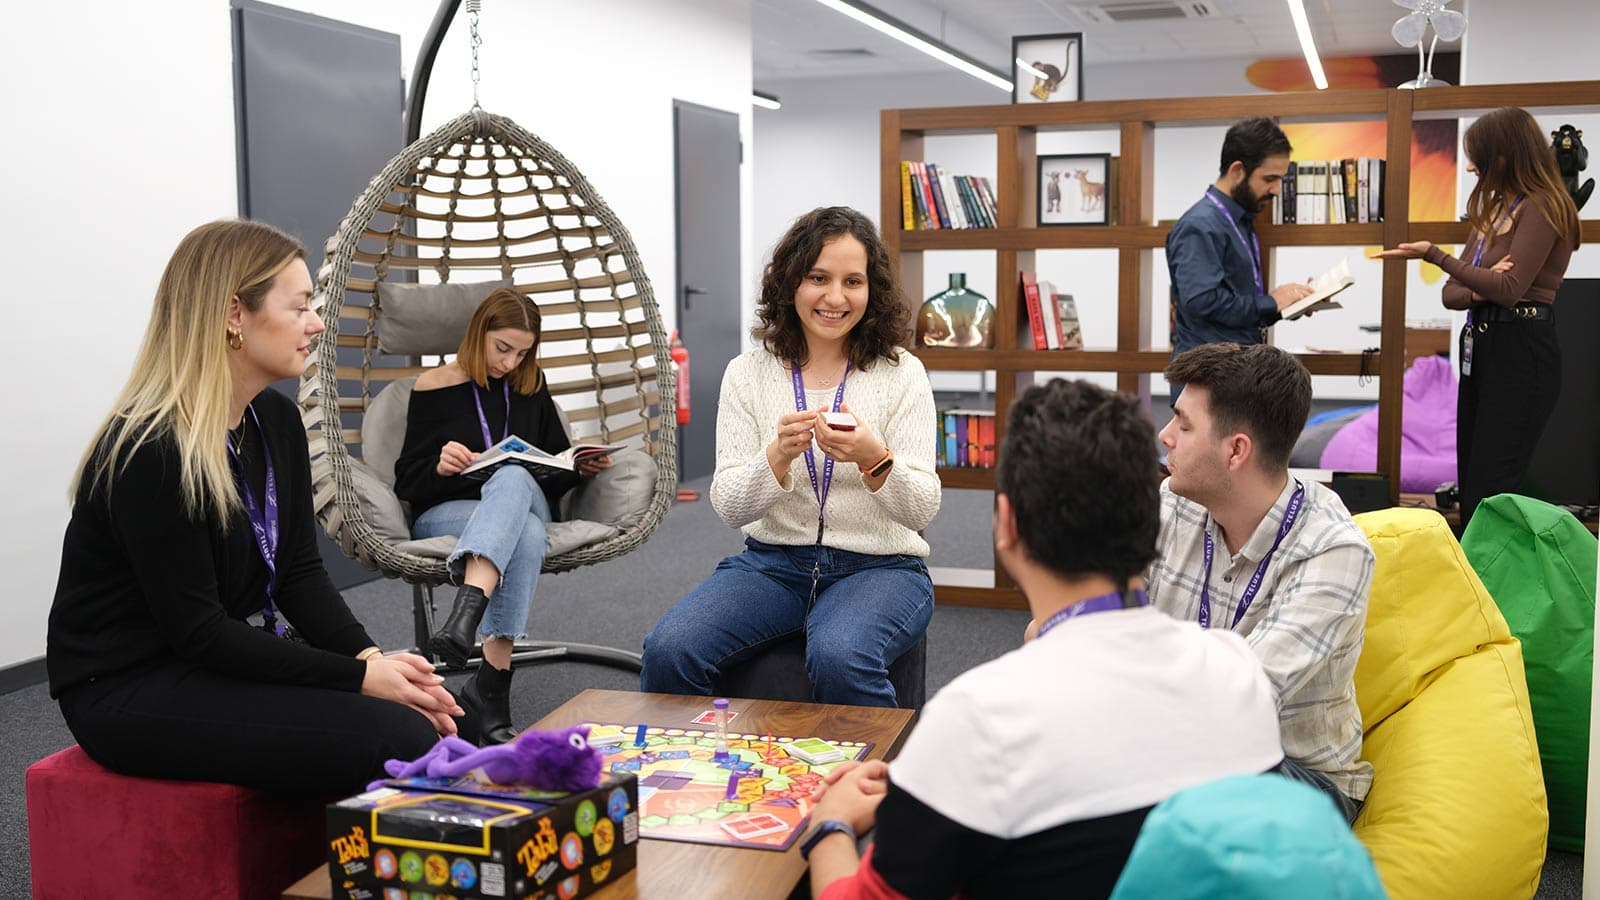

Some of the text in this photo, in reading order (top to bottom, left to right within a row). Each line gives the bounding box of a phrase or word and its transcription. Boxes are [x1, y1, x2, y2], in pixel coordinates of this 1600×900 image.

[1285, 499, 1299, 524] TELUS
[260, 534, 271, 559] TELUS
[1246, 572, 1260, 597] TELUS
